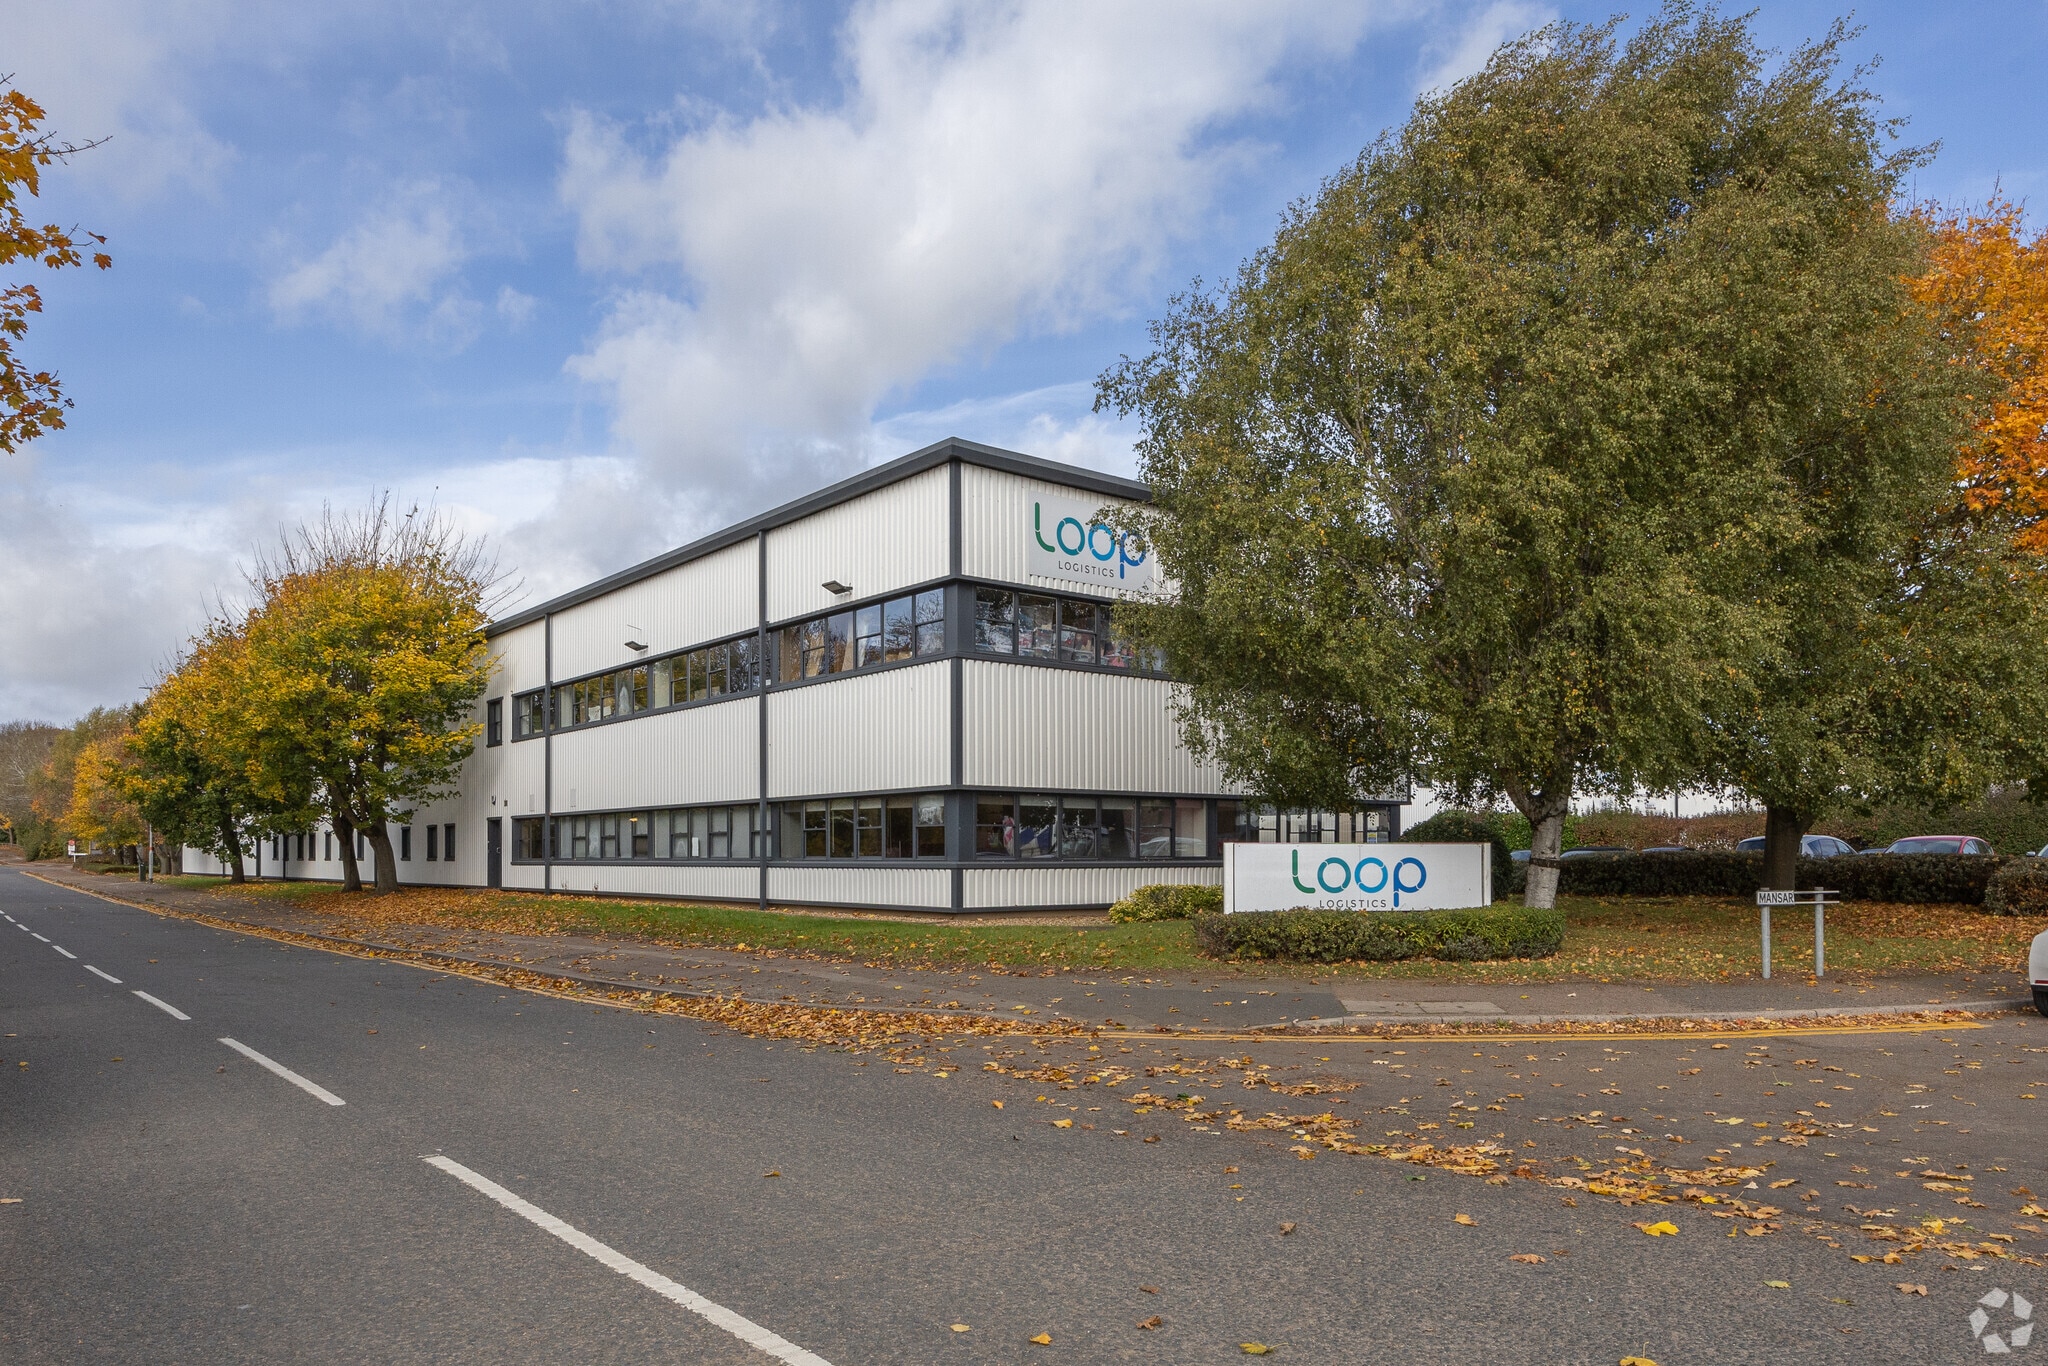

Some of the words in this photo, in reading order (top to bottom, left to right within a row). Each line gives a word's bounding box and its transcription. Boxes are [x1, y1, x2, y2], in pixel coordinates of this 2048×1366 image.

[1058, 560, 1115, 577] LOGISTICS
[1759, 893, 1794, 903] MANSAR
[1319, 899, 1387, 908] LOGISTICS
